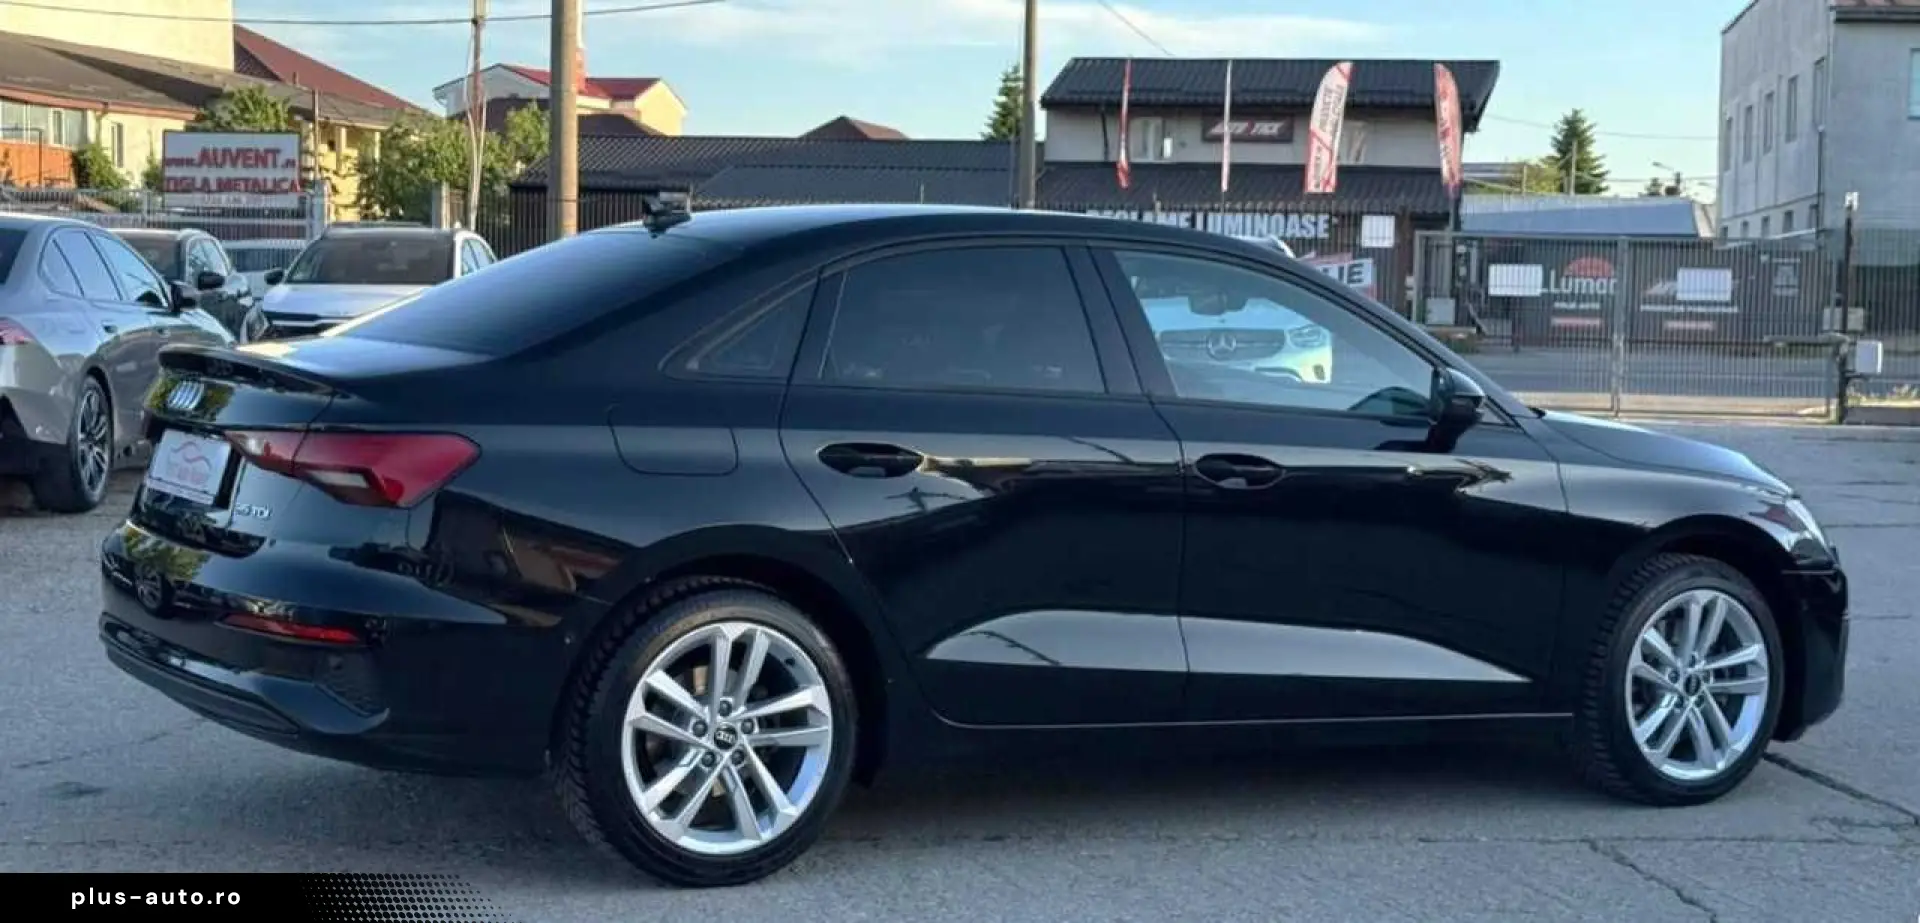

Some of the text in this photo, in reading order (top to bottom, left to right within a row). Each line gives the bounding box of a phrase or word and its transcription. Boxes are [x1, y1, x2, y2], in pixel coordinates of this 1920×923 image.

[215, 177, 302, 194] METALICA
[1196, 211, 1330, 238] LUMINOASE
[1322, 262, 1365, 284] IE
[1540, 269, 1618, 295] Lumar
